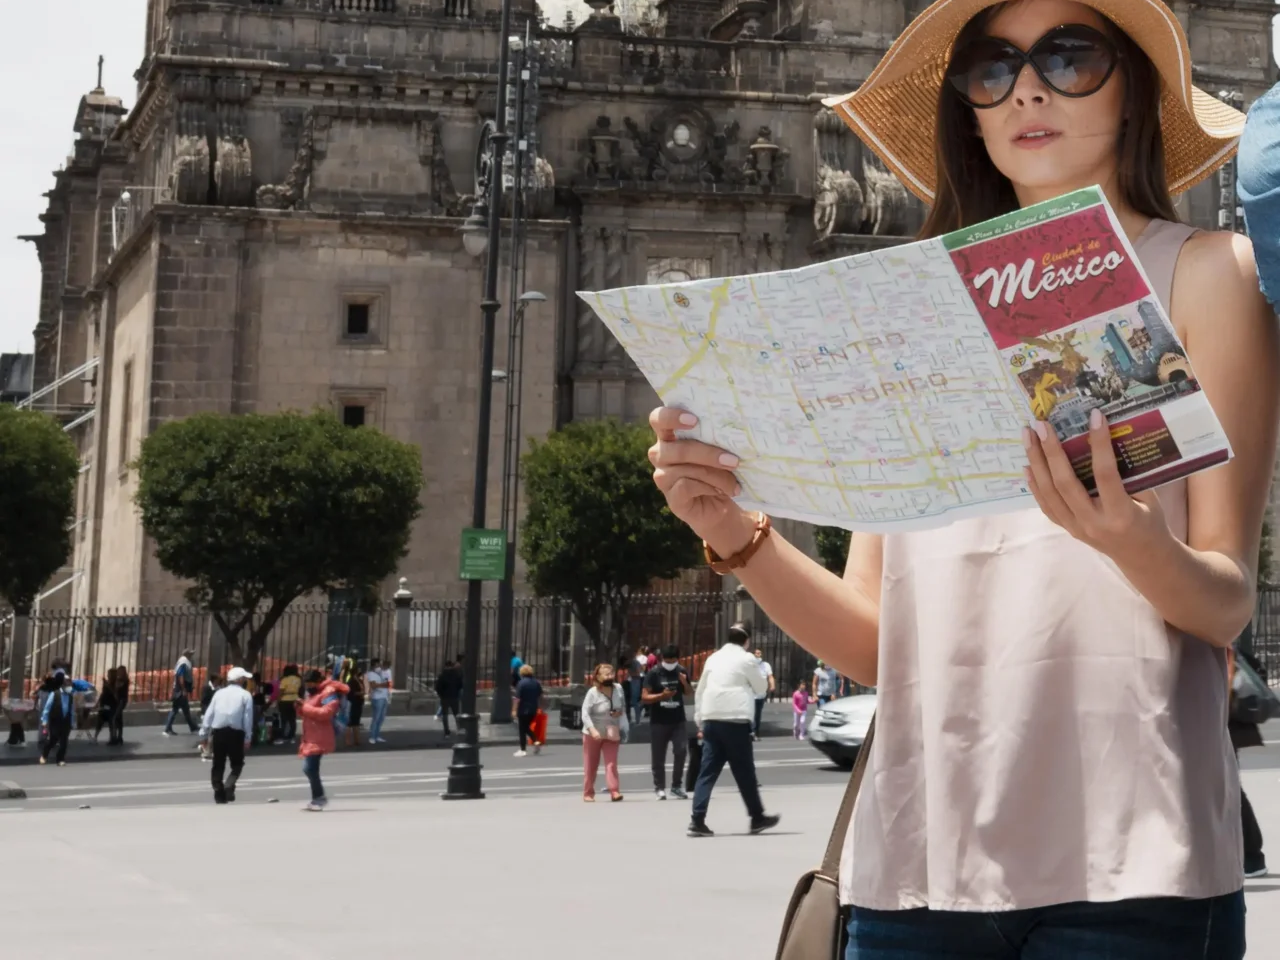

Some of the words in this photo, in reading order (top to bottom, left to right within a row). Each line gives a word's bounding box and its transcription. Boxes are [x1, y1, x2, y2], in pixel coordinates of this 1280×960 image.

[1042, 245, 1084, 266] Ciudad
[1087, 240, 1101, 251] de
[973, 250, 1125, 308] México
